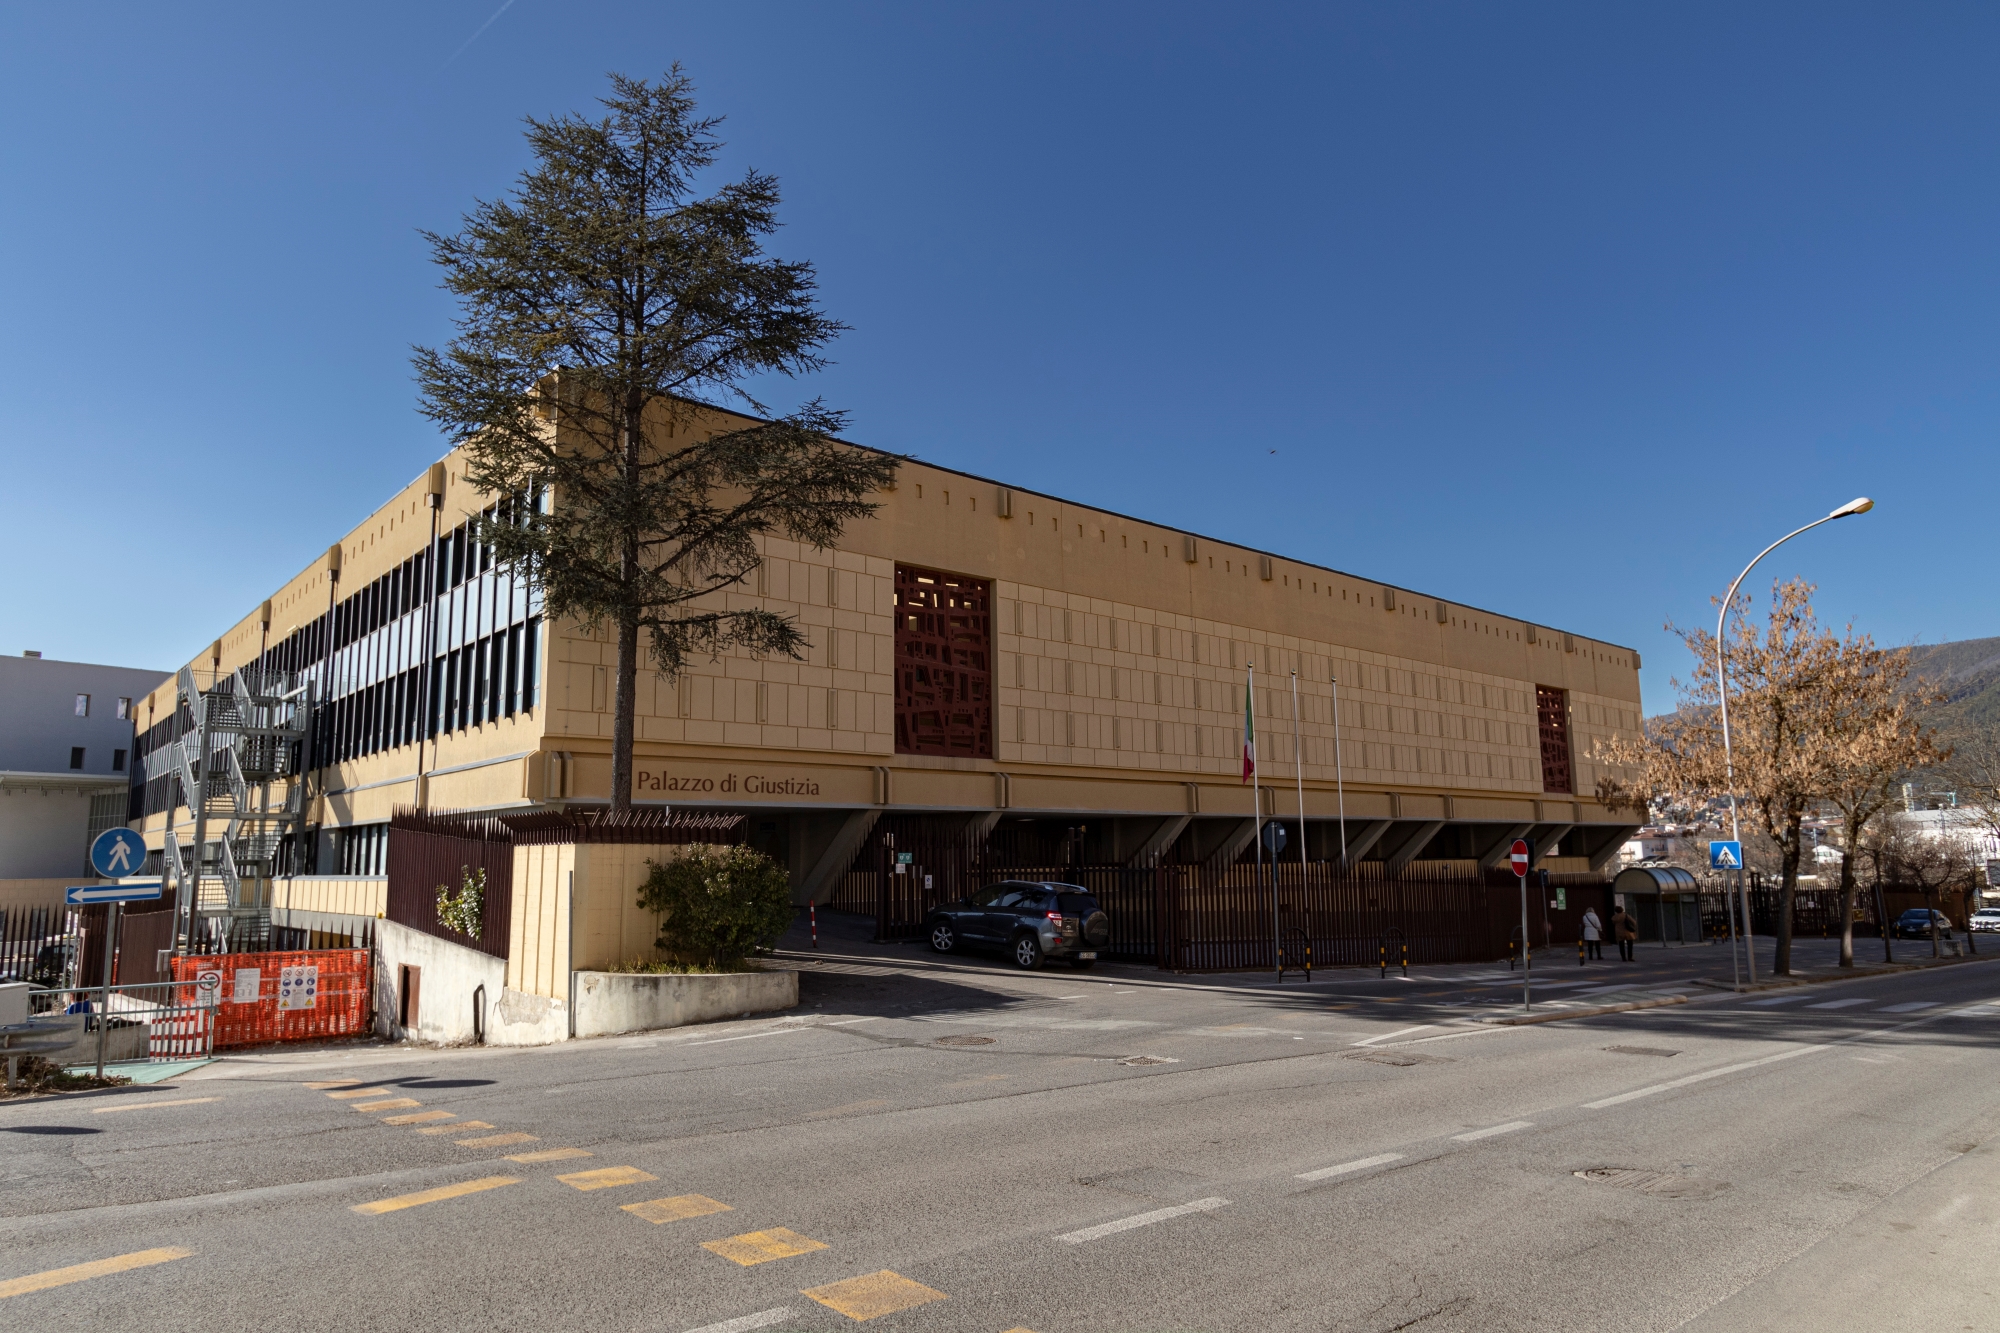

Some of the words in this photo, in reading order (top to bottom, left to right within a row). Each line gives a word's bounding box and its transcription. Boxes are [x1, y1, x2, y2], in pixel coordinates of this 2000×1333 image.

[637, 770, 715, 792] Palazzo
[720, 773, 737, 793] di
[744, 775, 820, 796] Giustizia
